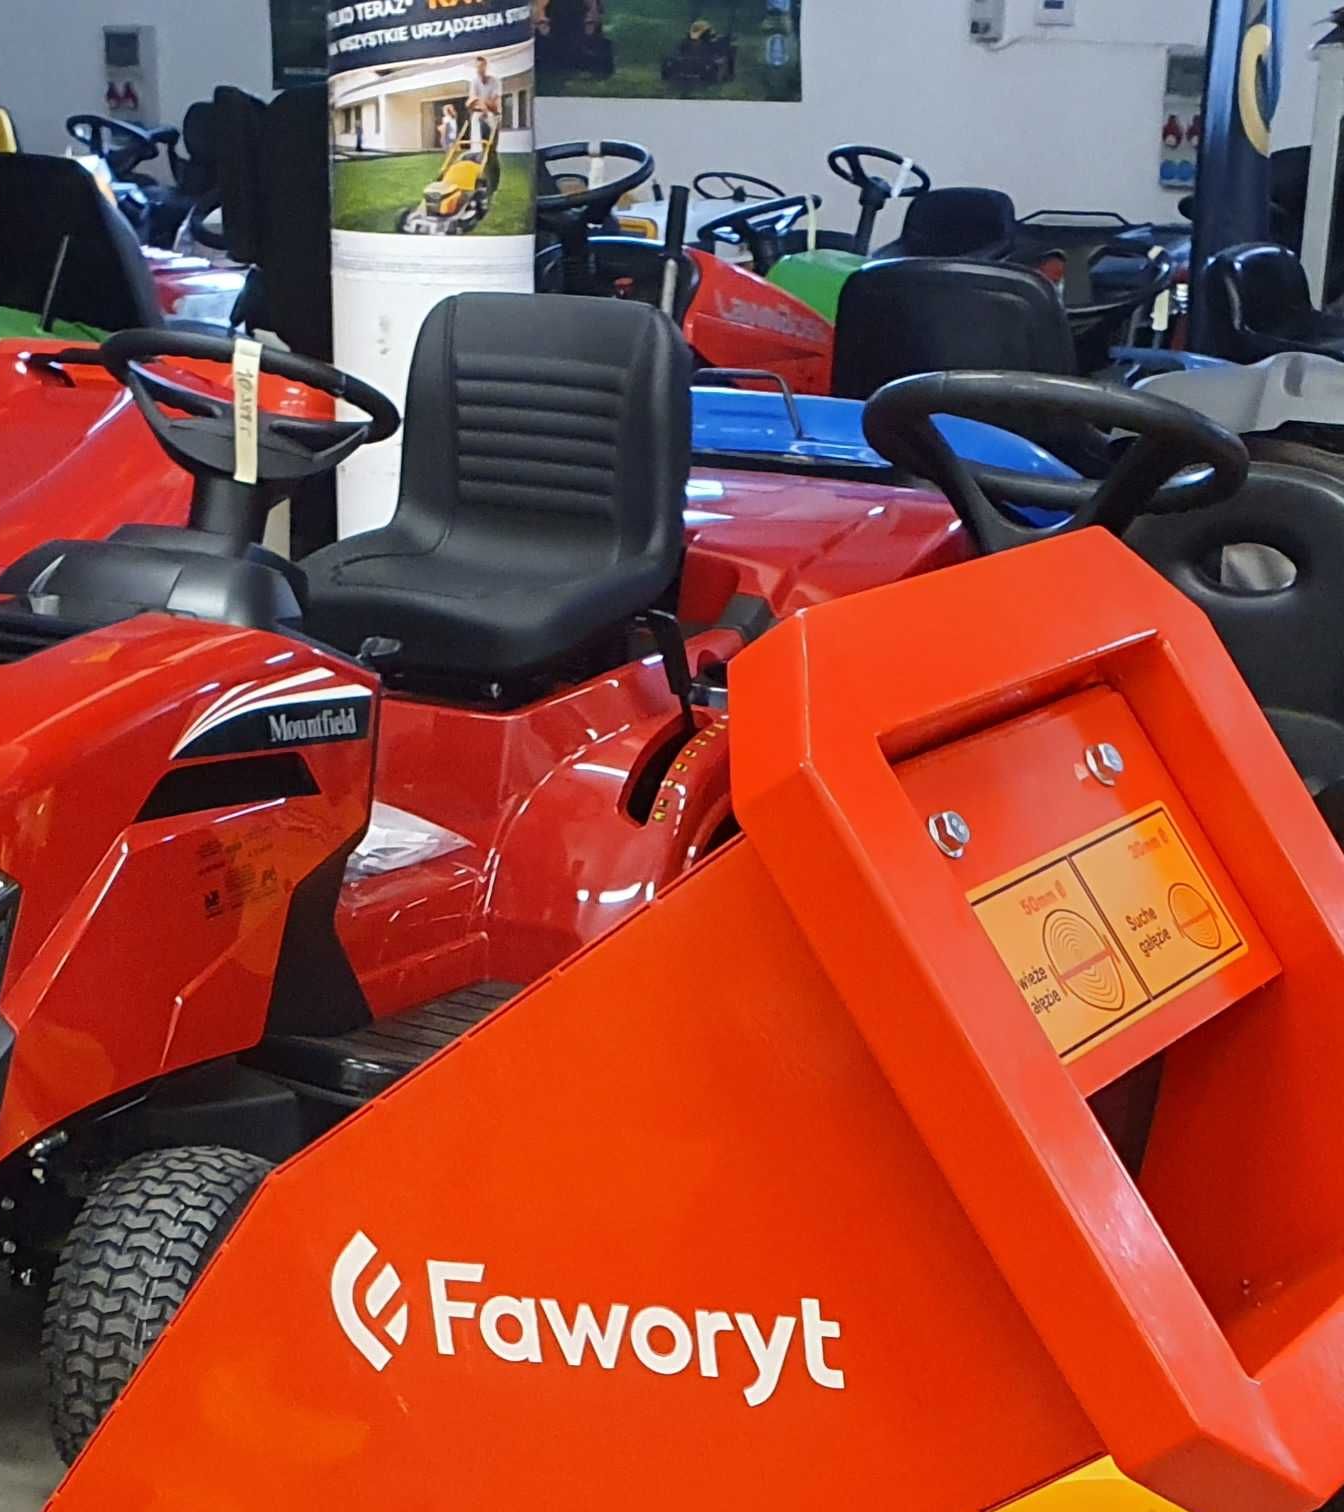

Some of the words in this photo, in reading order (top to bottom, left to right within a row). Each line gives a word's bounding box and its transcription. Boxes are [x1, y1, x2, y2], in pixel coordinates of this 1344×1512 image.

[411, 12, 504, 40] URZĄDZENIA
[268, 707, 357, 742] Mountfield
[1126, 904, 1158, 931] Suche
[1018, 964, 1049, 992] wieże
[426, 1259, 845, 1407] Faworyt
